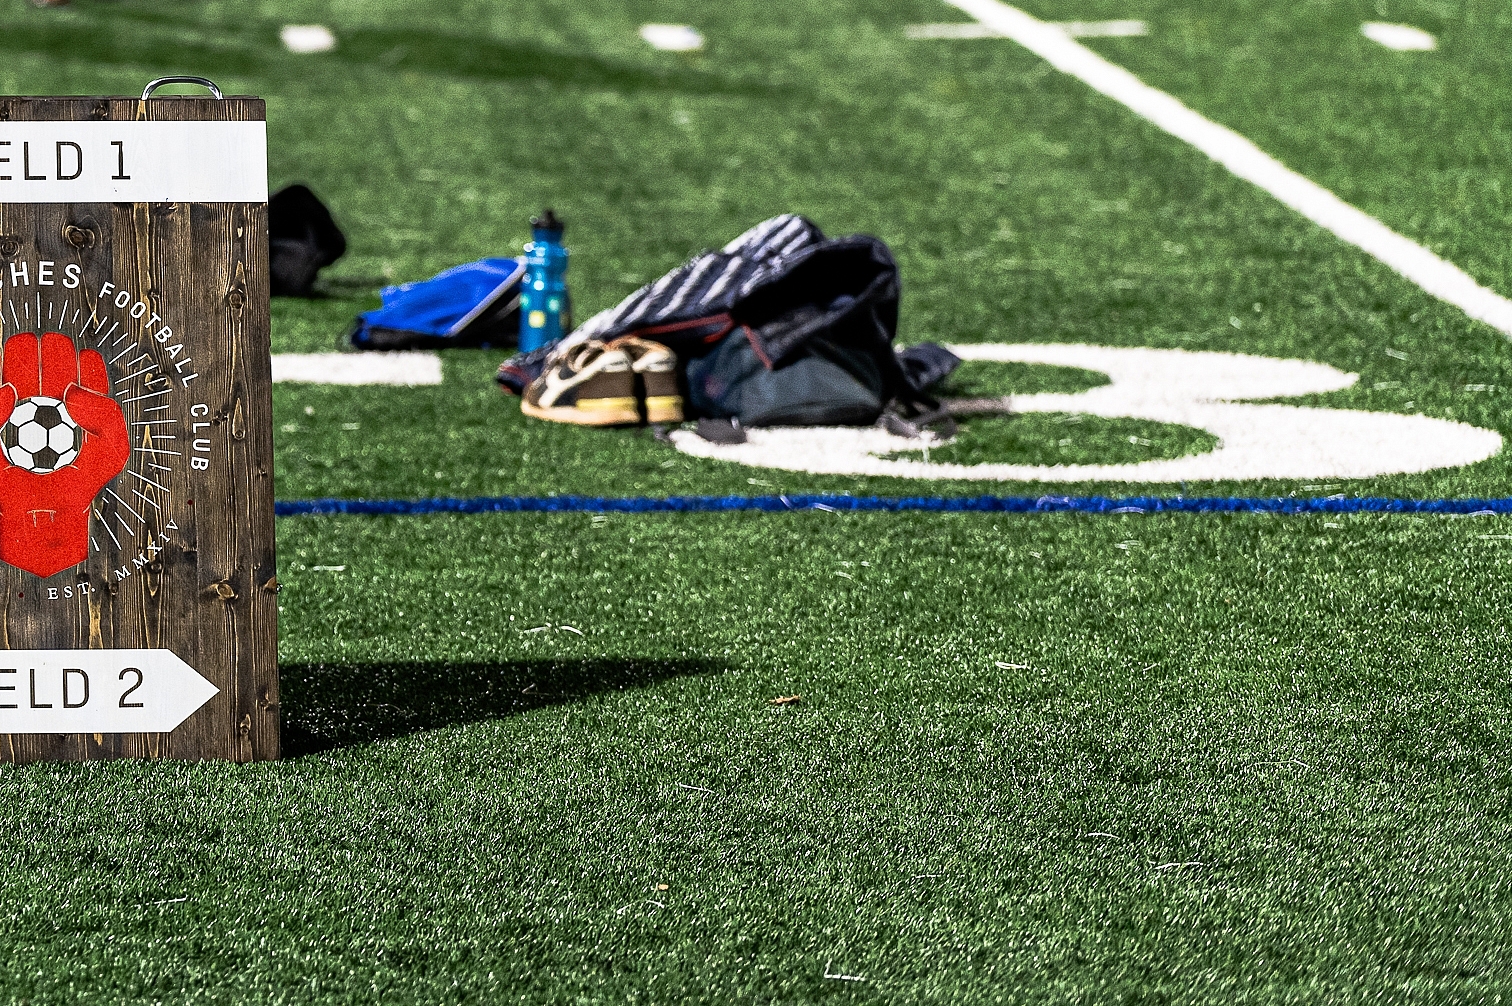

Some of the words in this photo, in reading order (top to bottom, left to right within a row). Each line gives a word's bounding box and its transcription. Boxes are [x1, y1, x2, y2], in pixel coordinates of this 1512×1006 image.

[110, 140, 132, 181] 1
[98, 282, 200, 388] FOOTBALL
[189, 403, 210, 472] CLUB
[47, 582, 96, 600] EST.
[114, 519, 178, 582] MMXIV
[118, 667, 144, 709] 2
